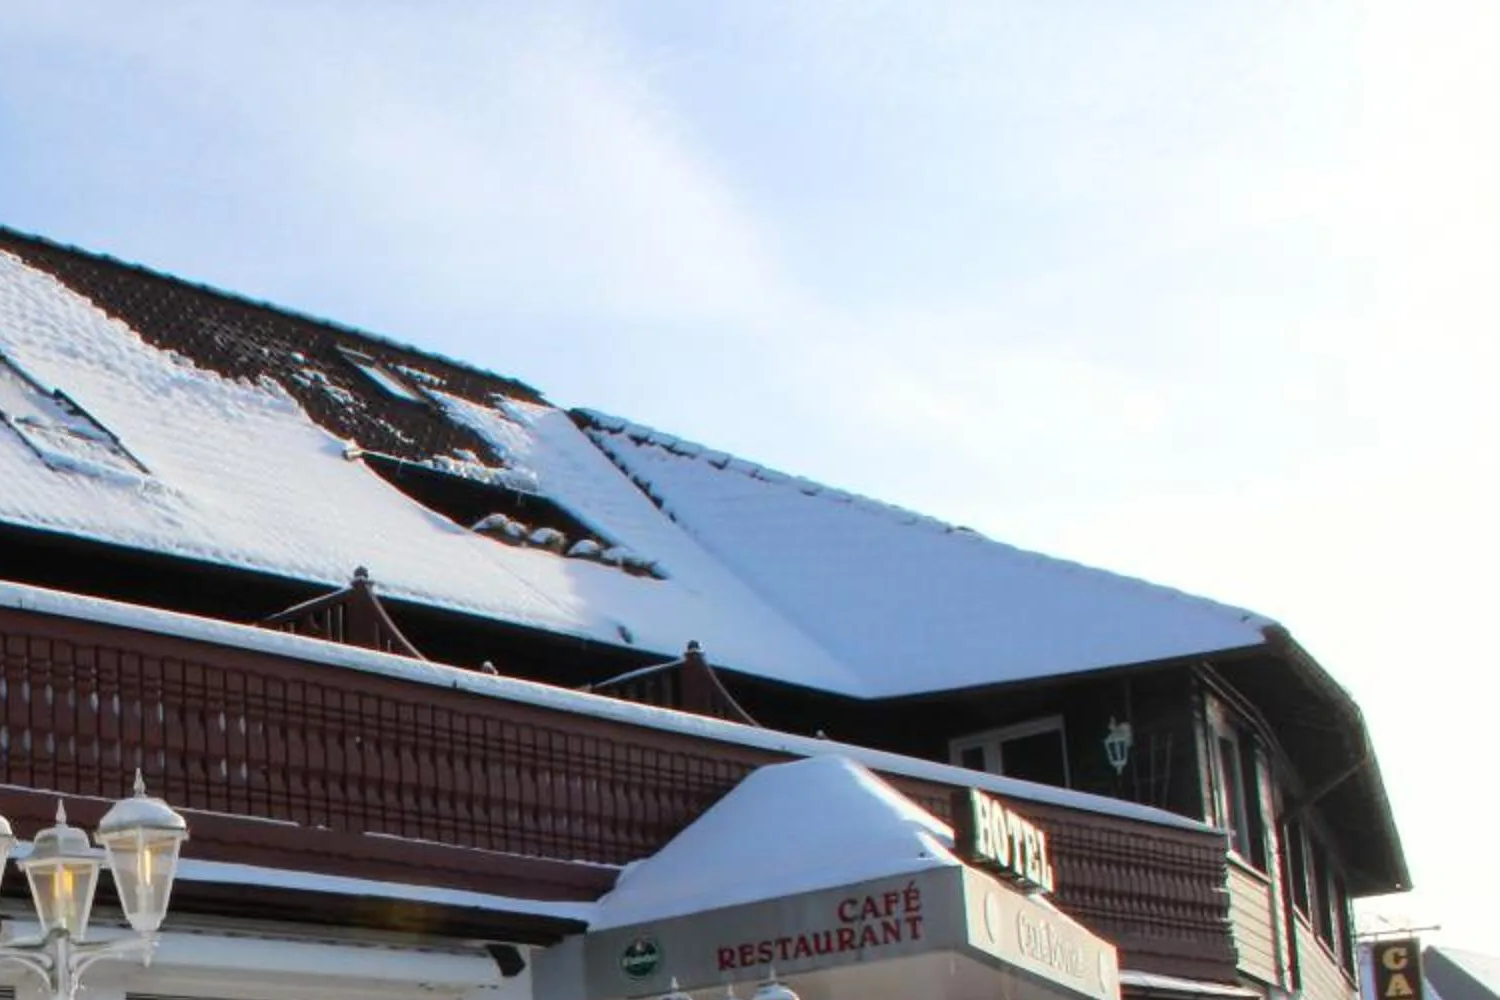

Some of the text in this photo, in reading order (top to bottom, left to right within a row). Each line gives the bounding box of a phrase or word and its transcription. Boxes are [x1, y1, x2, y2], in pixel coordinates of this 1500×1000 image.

[971, 788, 1055, 894] HOTEL
[838, 879, 922, 923] CAFÉ
[717, 915, 923, 971] RESTAURANT
